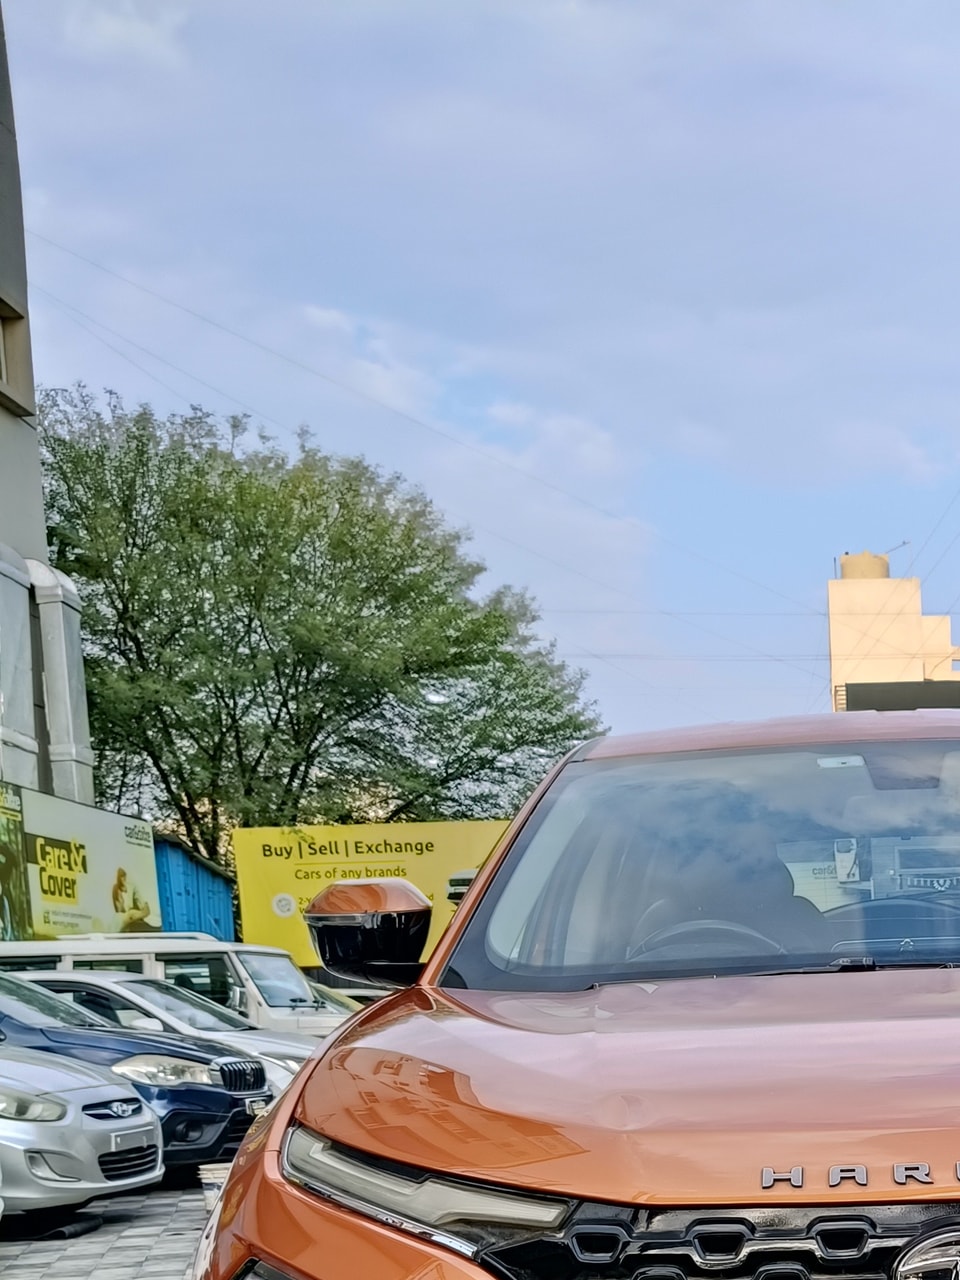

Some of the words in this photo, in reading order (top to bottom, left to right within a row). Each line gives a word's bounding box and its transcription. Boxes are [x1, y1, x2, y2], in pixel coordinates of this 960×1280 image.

[36, 837, 69, 869] Care
[262, 843, 293, 859] Buy
[307, 841, 339, 856] Sell
[354, 839, 434, 855] Exchange
[39, 866, 77, 899] Cover
[294, 868, 321, 880] Cars
[325, 867, 337, 879] of
[341, 868, 361, 880] any
[365, 866, 407, 878] brands
